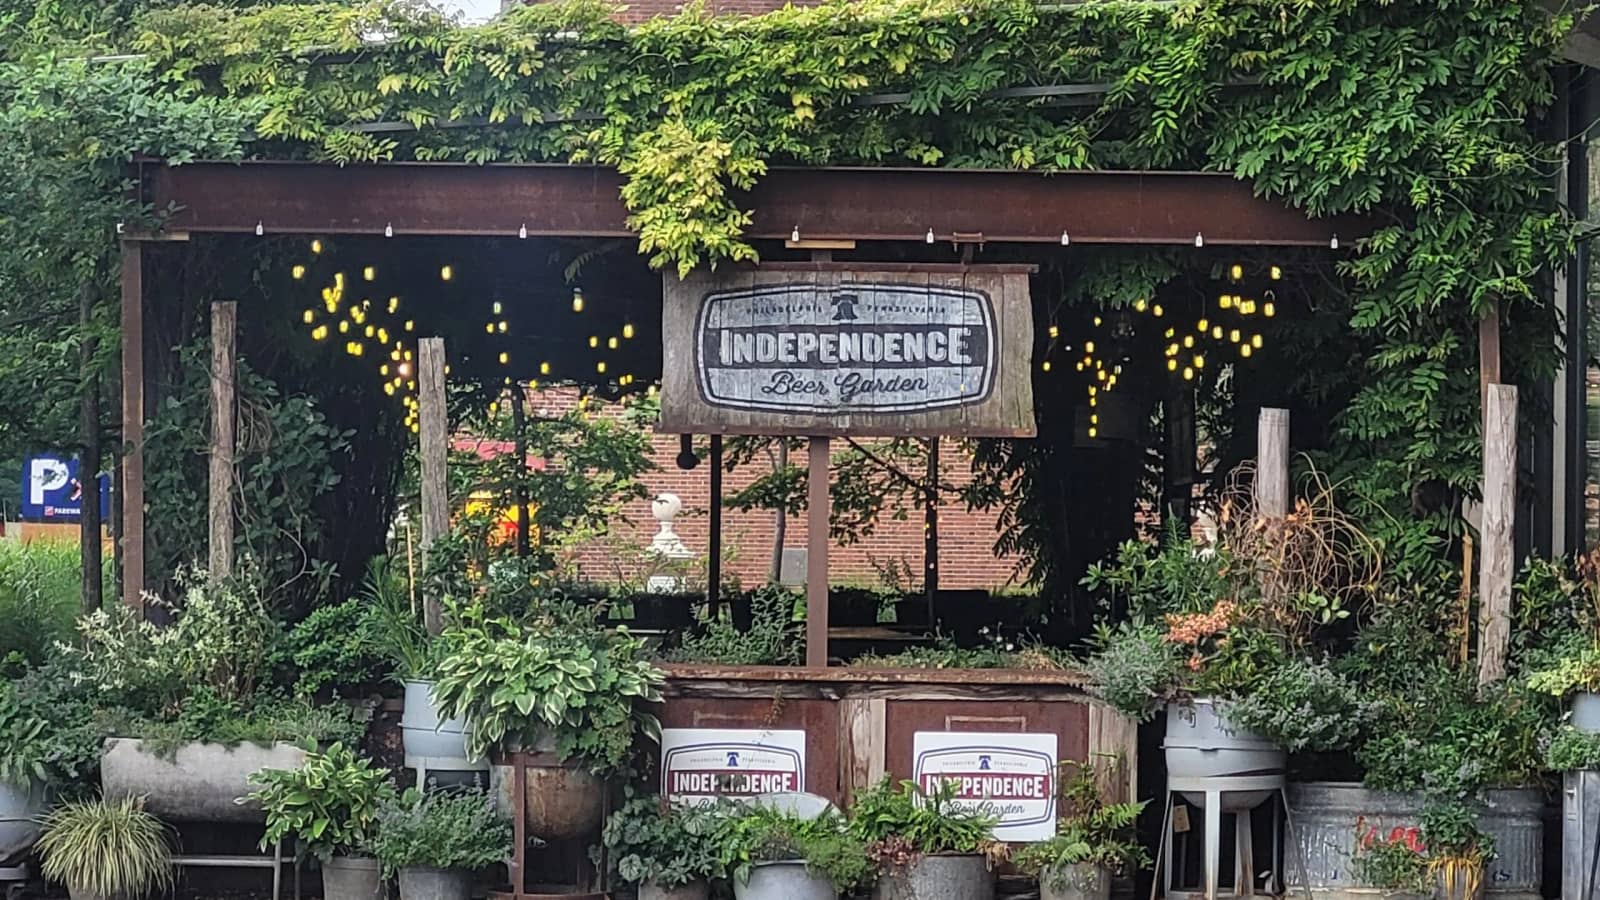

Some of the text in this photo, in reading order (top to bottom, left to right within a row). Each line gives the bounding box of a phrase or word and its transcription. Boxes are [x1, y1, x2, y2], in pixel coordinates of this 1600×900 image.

[719, 327, 972, 366] INDEPENDENCE
[761, 371, 928, 401] Beer Garden
[30, 459, 69, 504] P
